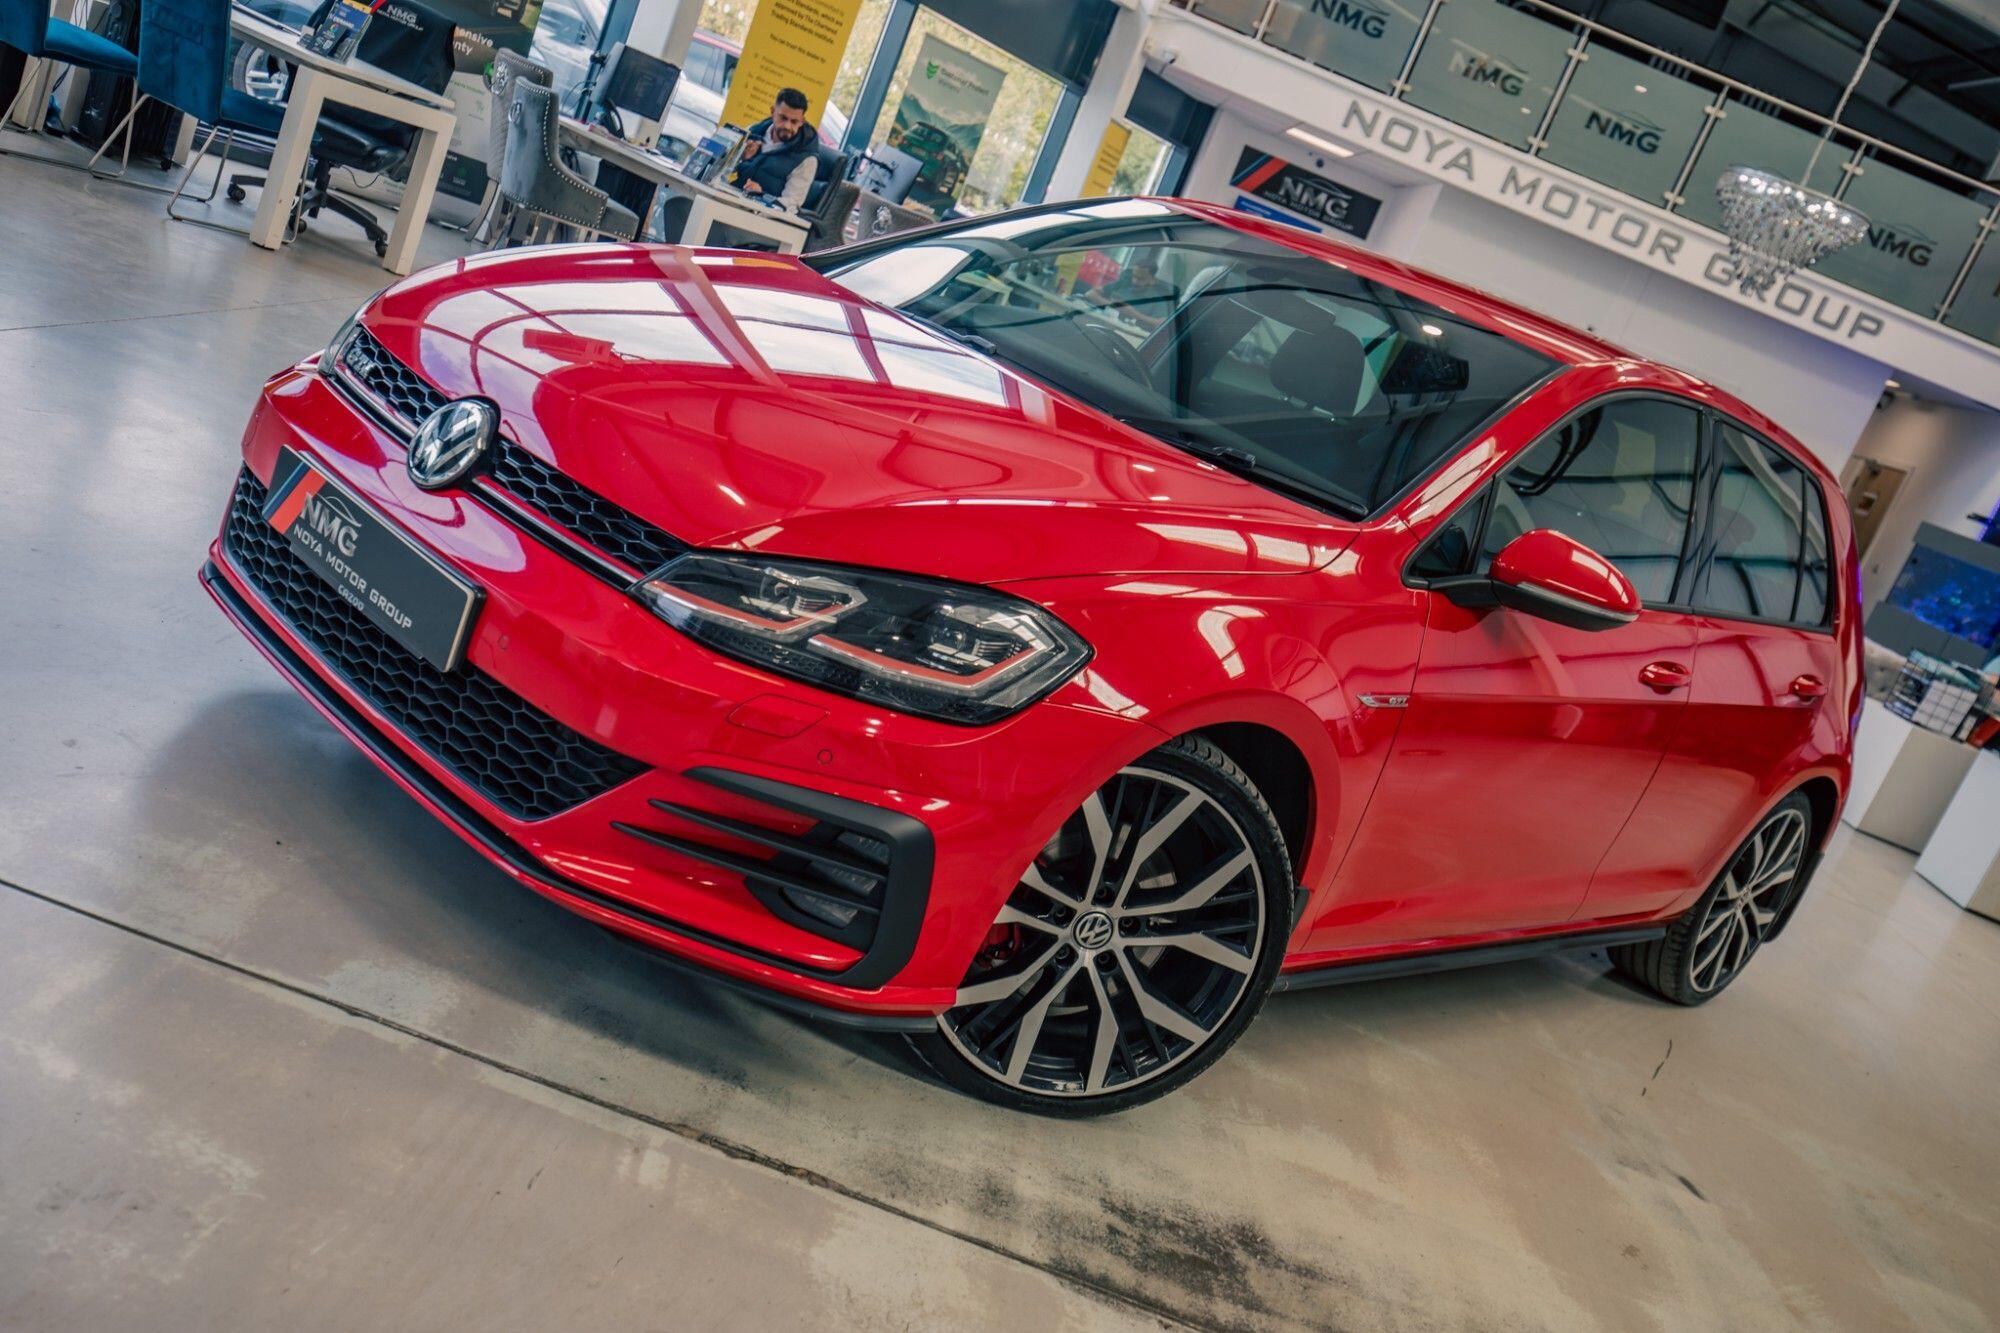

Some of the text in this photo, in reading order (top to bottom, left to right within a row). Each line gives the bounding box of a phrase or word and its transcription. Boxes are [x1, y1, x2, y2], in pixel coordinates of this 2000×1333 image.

[387, 4, 418, 23] NMG
[1310, 0, 1386, 38] NMG
[1584, 109, 1662, 155] NMG
[1278, 175, 1350, 219] NMG
[1342, 100, 1475, 181] NOYA
[1500, 166, 1685, 265] MOTOR
[300, 491, 359, 557] NMG
[293, 523, 413, 629] NOYA MOTOR GROUP
